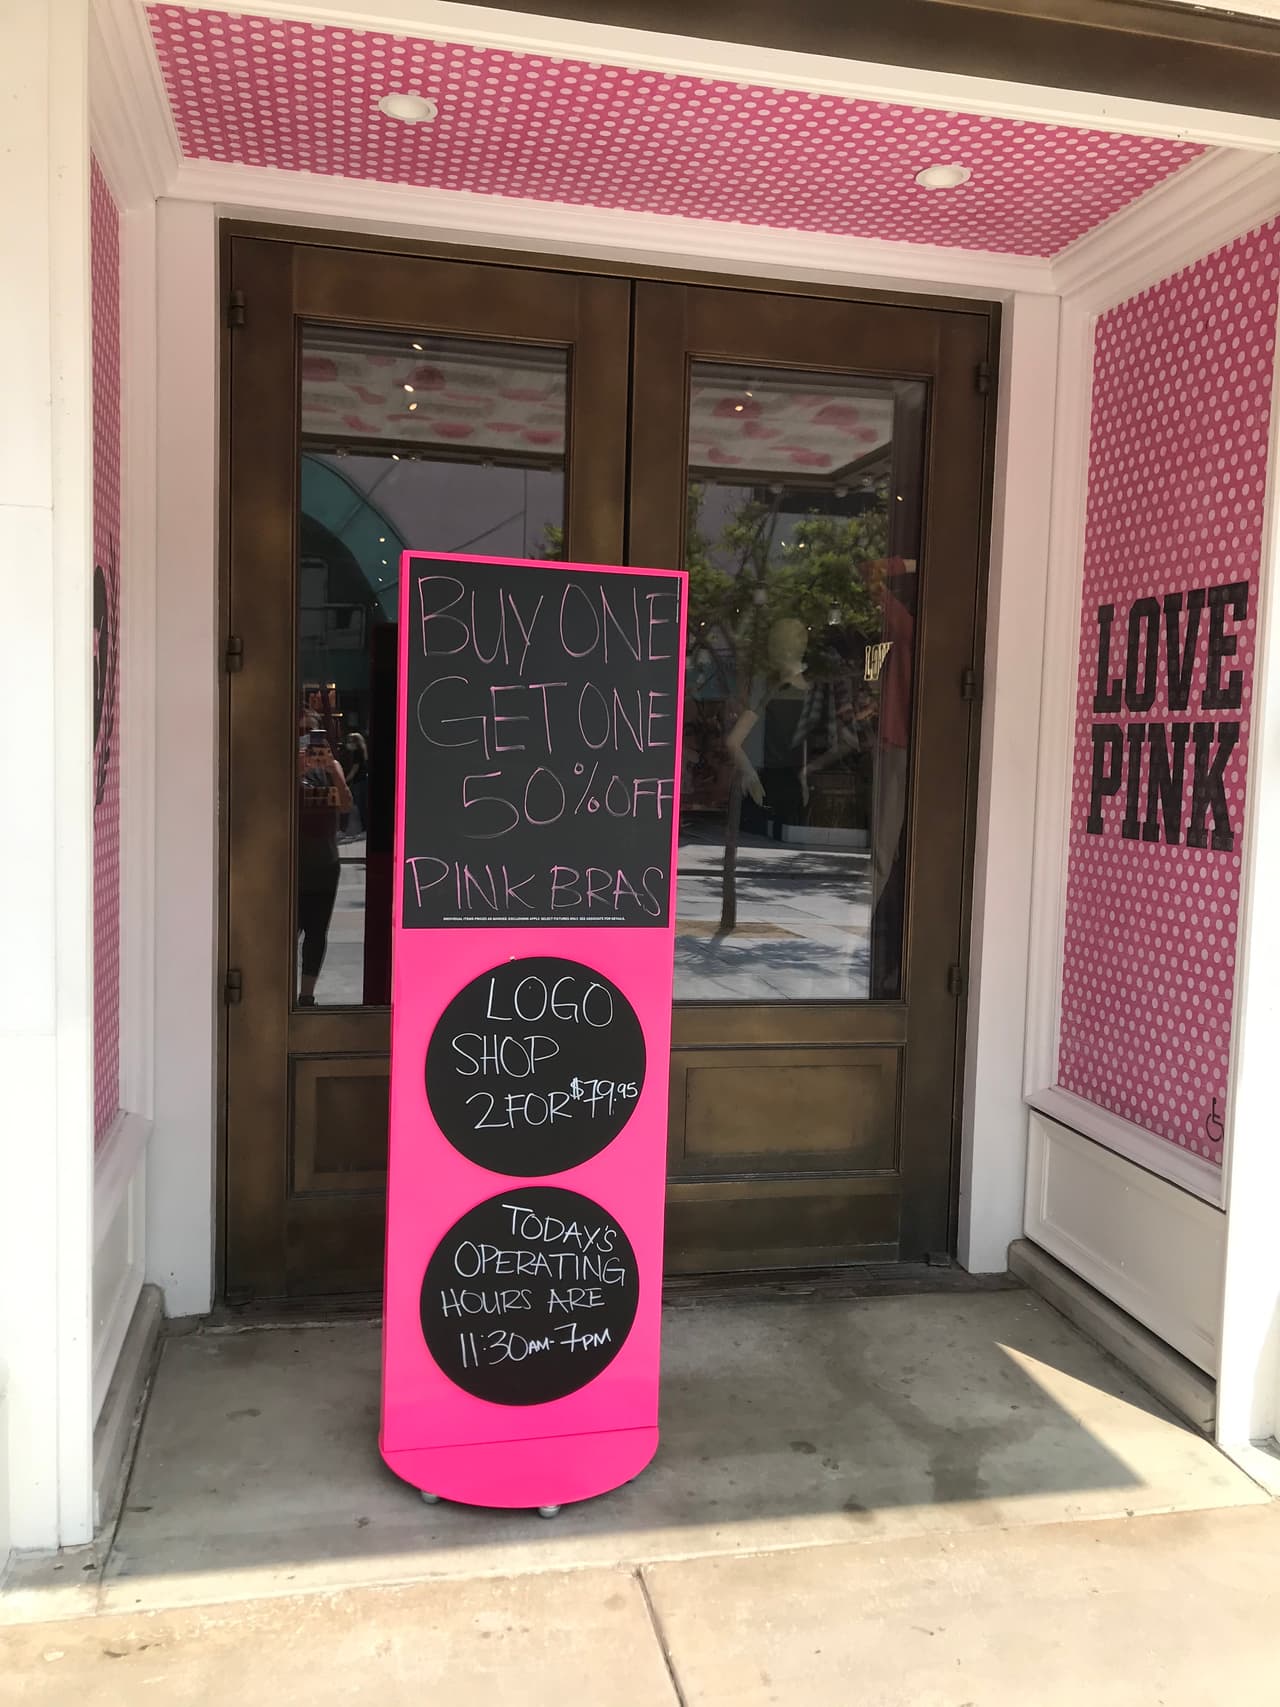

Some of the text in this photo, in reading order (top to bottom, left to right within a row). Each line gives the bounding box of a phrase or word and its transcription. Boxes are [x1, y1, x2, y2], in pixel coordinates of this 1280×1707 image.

[418, 575, 677, 676] BUY ONE
[1093, 581, 1249, 713] LOVE
[417, 676, 670, 760] GET ONE
[1087, 721, 1240, 852] PINK
[406, 856, 664, 916] PINK BRAS
[487, 976, 613, 1027] LOGO
[451, 1033, 560, 1078] SHOP
[502, 1204, 617, 1253] TODAY'S
[454, 1241, 626, 1287] OPERATING
[441, 1287, 605, 1318] HOURS ARE
